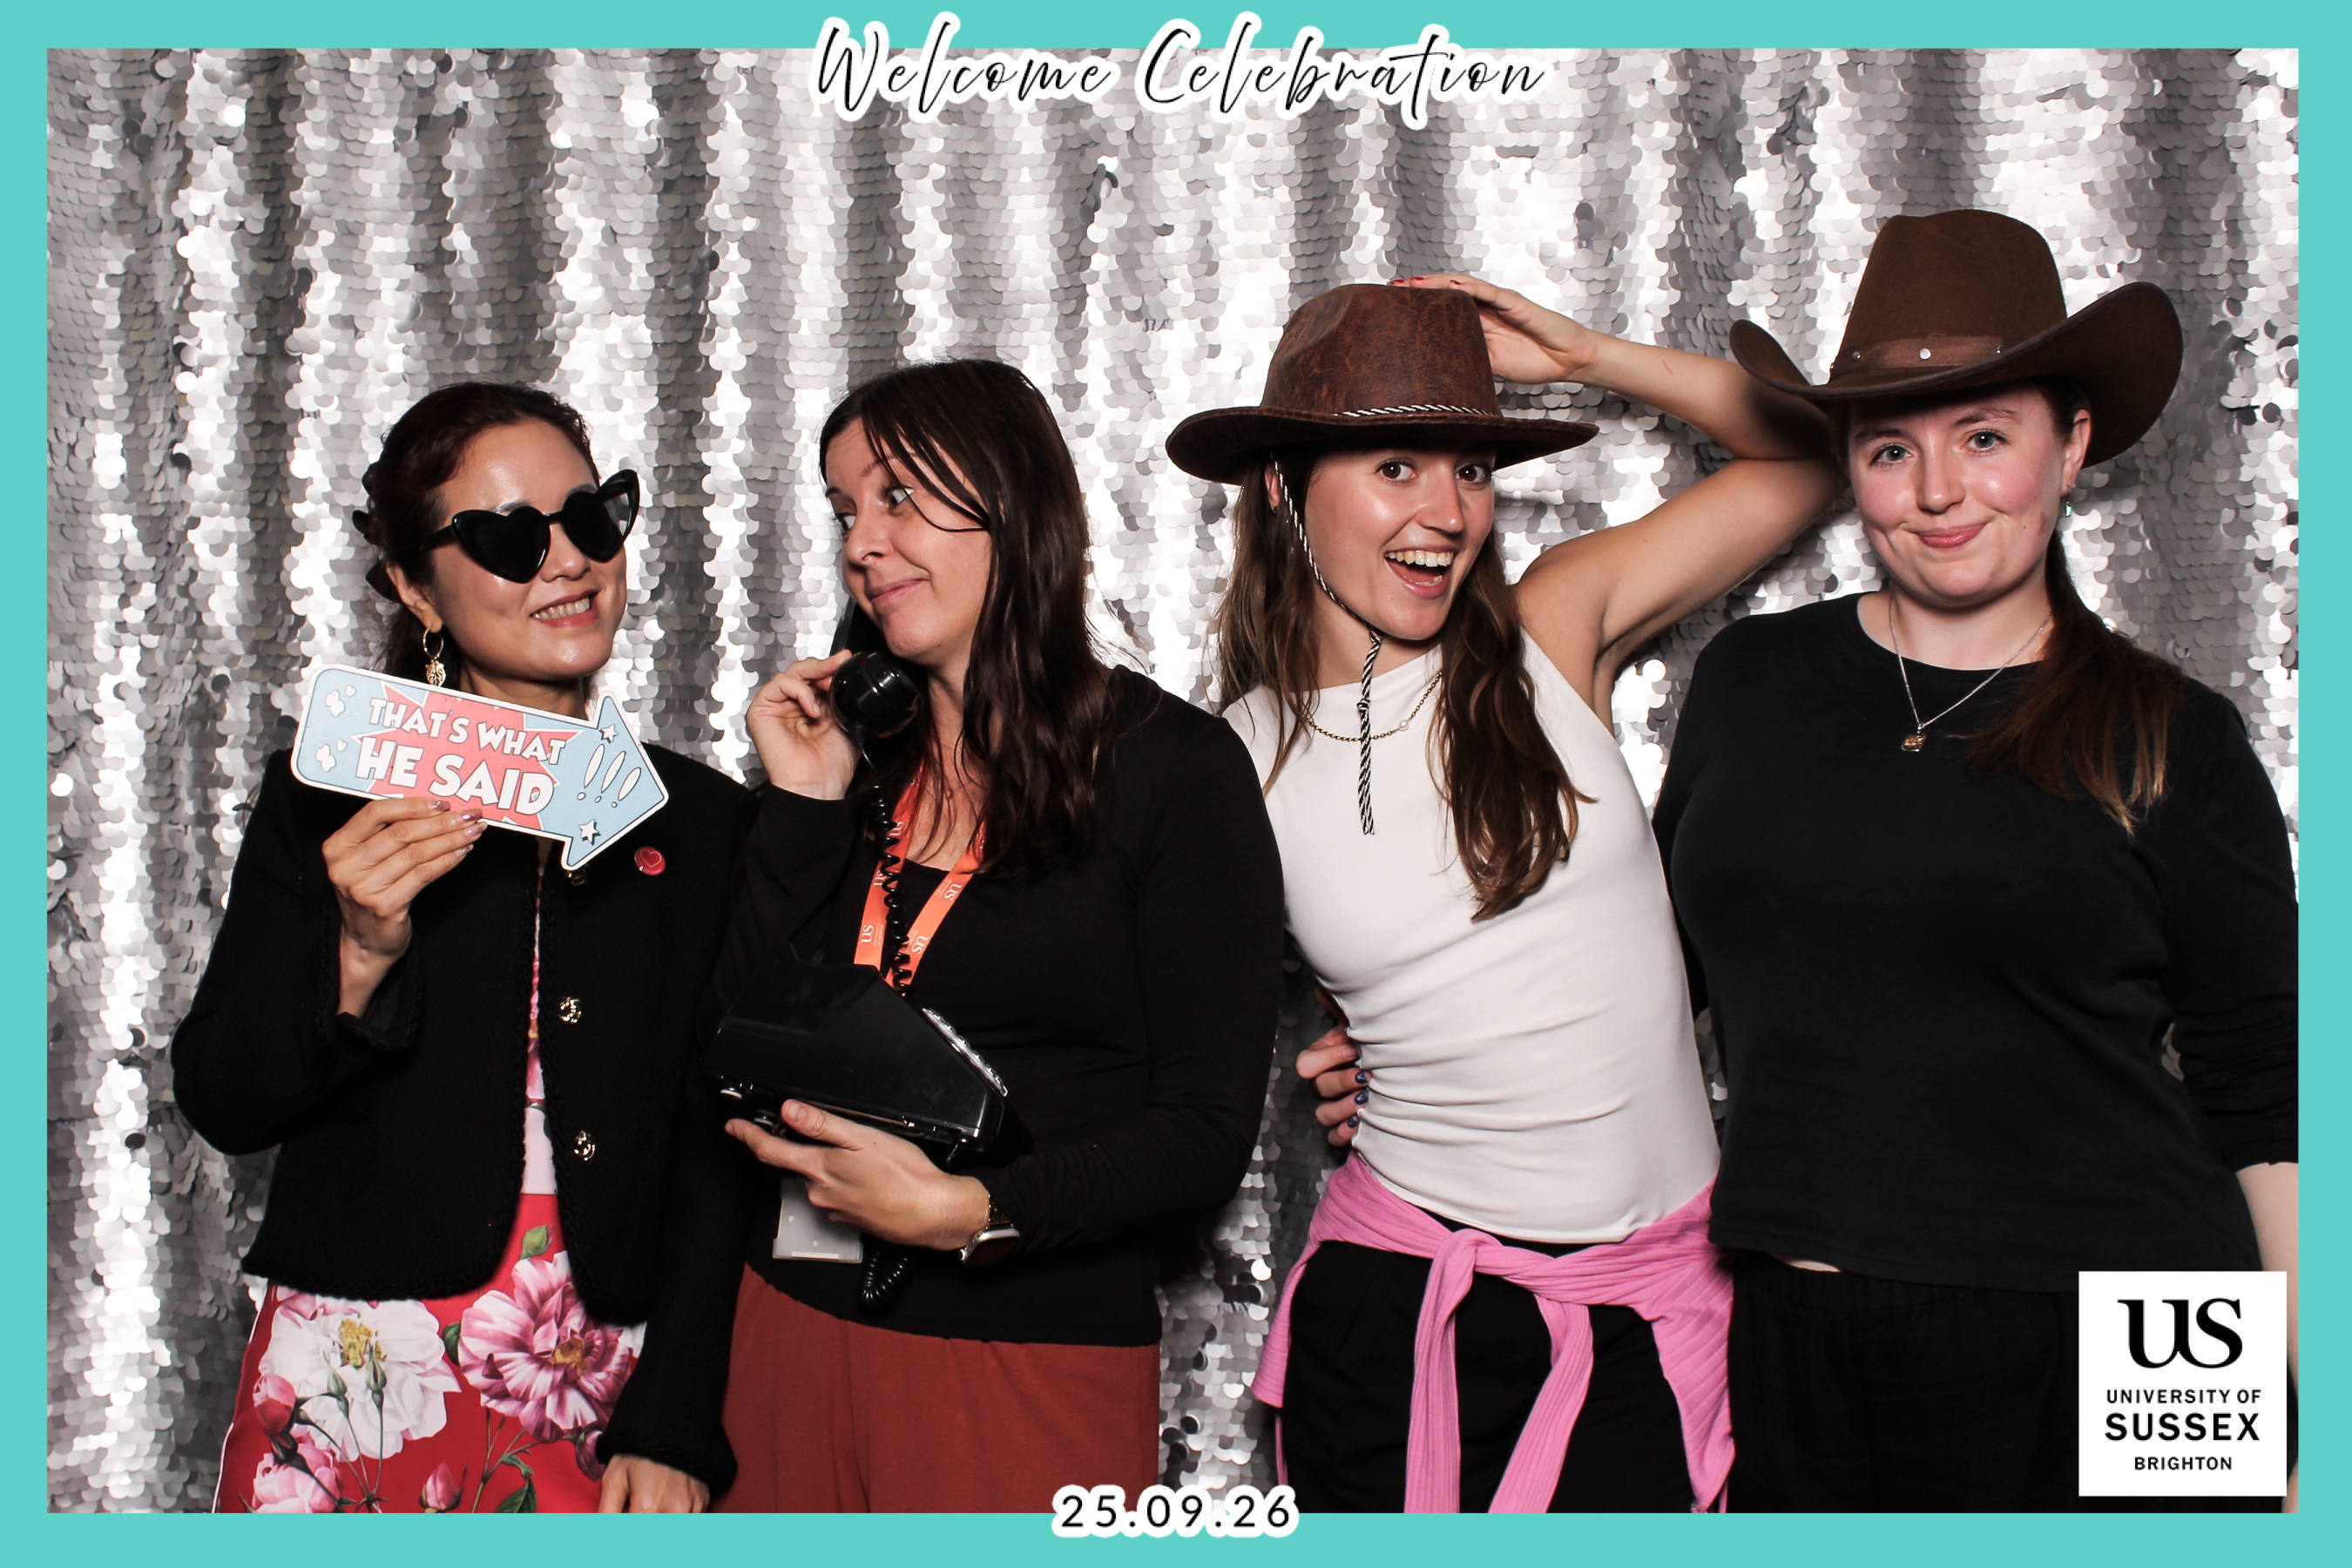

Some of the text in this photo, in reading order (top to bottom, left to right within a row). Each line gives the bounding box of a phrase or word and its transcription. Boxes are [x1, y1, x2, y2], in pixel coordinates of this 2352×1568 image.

[368, 698, 567, 765] THAT'S WHAT
[355, 736, 556, 815] HE SAID
